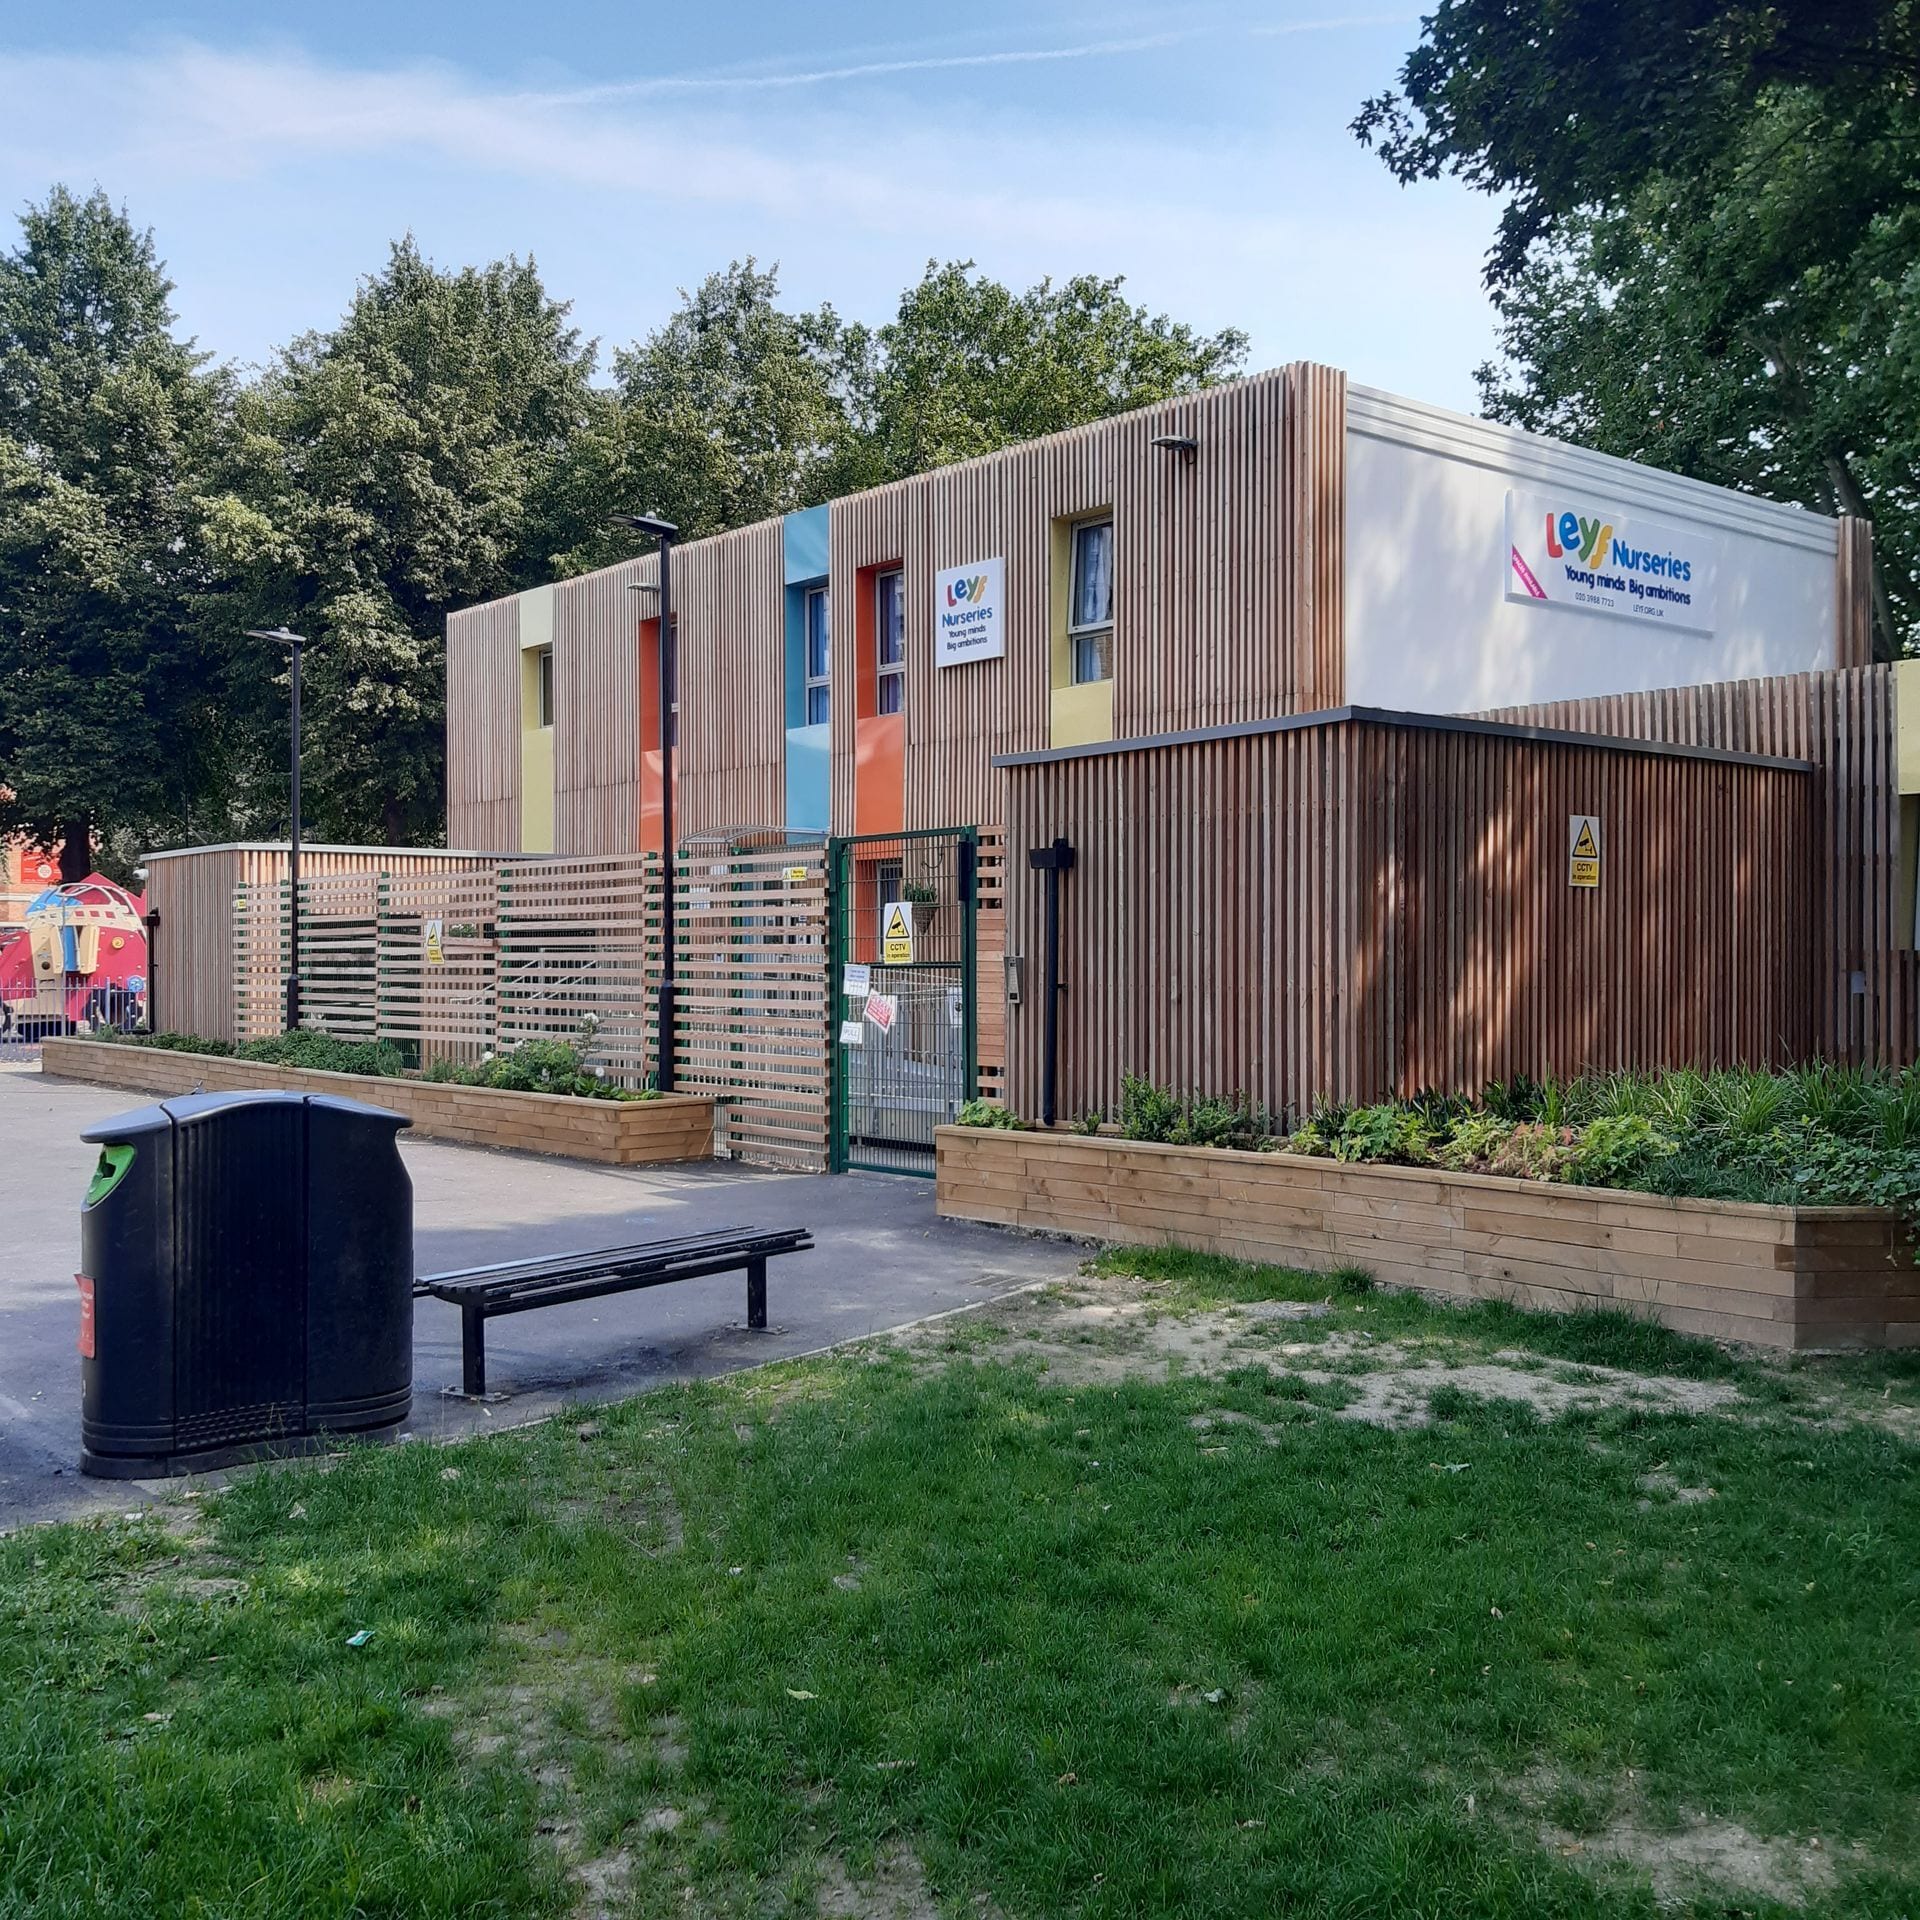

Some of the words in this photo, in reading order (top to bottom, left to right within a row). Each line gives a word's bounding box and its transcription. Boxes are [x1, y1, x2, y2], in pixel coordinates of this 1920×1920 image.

[1612, 538, 1691, 582] Nurseries
[1565, 564, 1595, 589] Young
[1597, 573, 1626, 591] minds
[1629, 578, 1644, 599] Big
[1645, 584, 1691, 605] ambitions
[1575, 592, 1586, 602] 020
[942, 606, 992, 627] Nurseries
[948, 629, 966, 638] Young
[968, 624, 986, 635] minds
[946, 642, 956, 652] Big
[957, 636, 987, 648] ambitions
[1577, 863, 1593, 872] CCTV
[890, 943, 906, 951] CCTV
